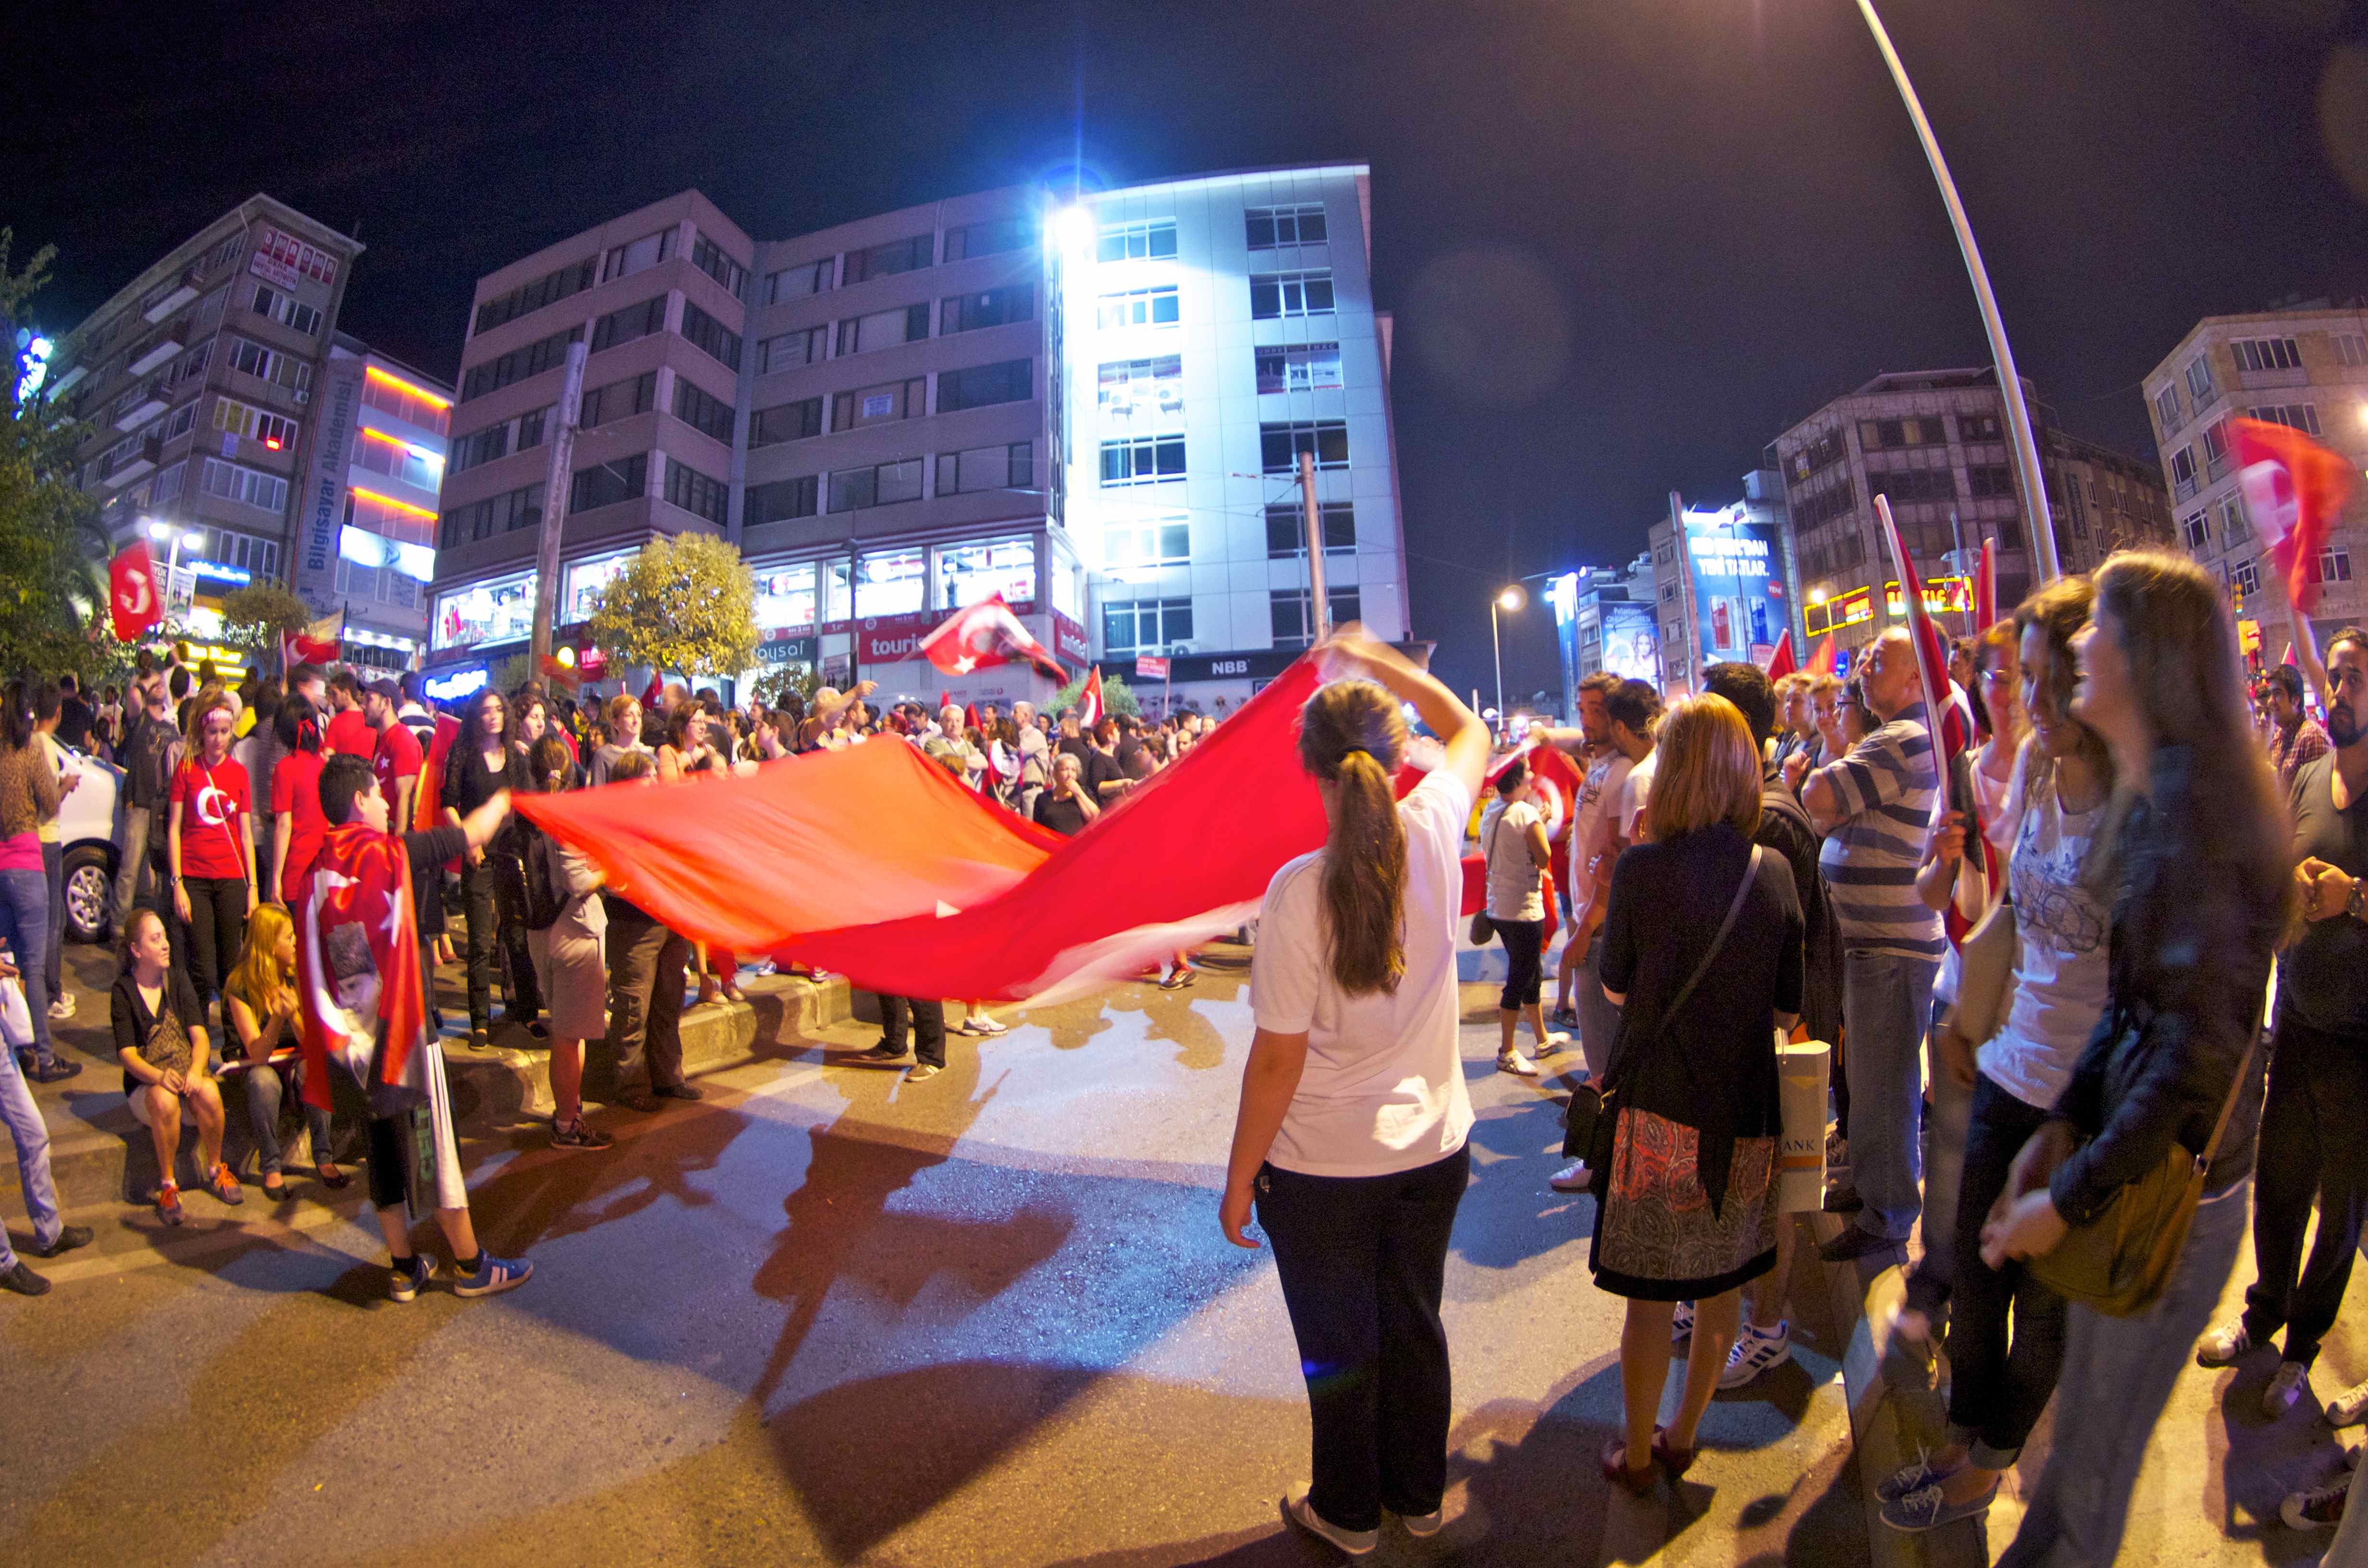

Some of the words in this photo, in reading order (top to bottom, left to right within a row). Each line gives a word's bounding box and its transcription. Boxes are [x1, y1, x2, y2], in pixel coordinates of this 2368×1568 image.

[308, 479, 335, 570] Bilgisayar
[1725, 559, 1770, 576] TATLAR.
[753, 640, 804, 661] aysal
[871, 633, 924, 656] touris
[1212, 660, 1247, 674] NBB
[1784, 1139, 1815, 1151] ANK
